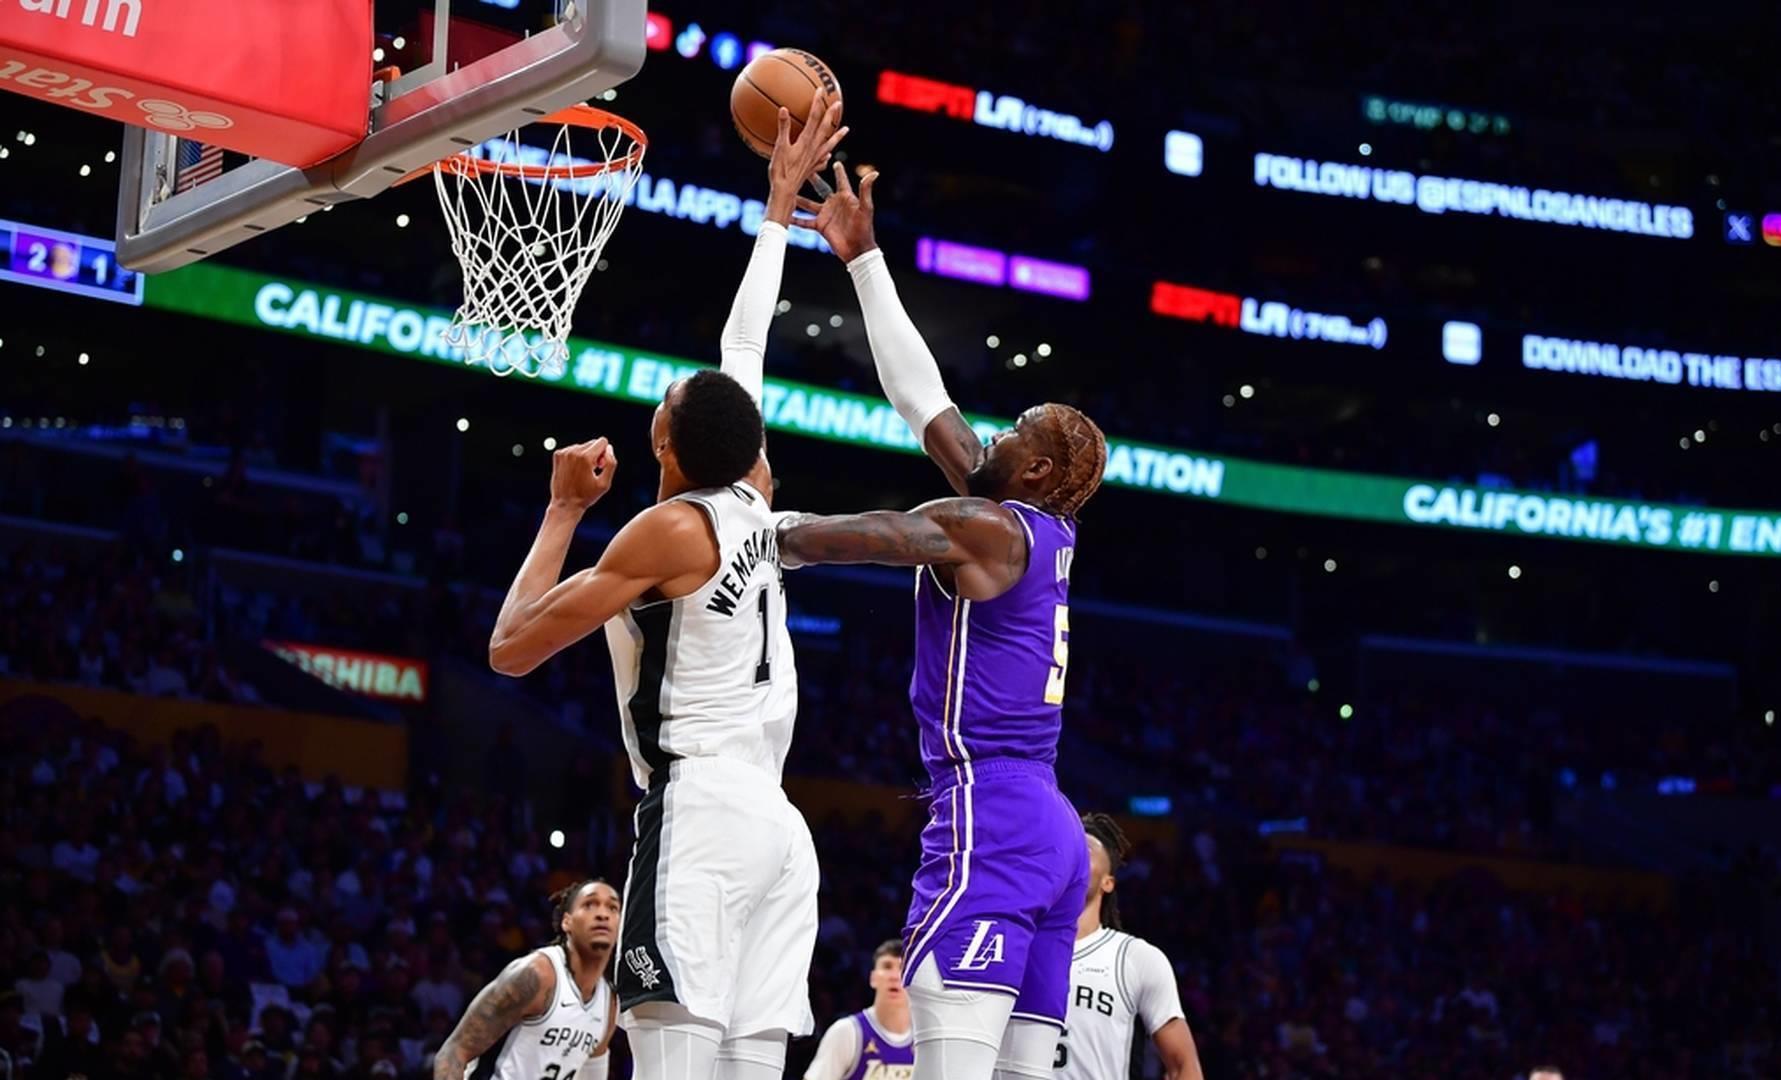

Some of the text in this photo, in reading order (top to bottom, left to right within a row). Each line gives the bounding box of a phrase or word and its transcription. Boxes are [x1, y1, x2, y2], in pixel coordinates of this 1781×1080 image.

[637, 173, 676, 216] LA
[676, 184, 741, 229] APP
[1254, 152, 1694, 239] FOLLOW US @ESPNLOSANGELES
[28, 242, 48, 272] 2
[91, 254, 108, 285] 1
[572, 348, 625, 391] #1
[1522, 334, 1683, 384] DOWNLOAD
[1683, 353, 1742, 390] THE
[1403, 484, 1673, 545] CALIFORNIA'S
[1677, 512, 1723, 549] #1
[753, 583, 772, 688] 1
